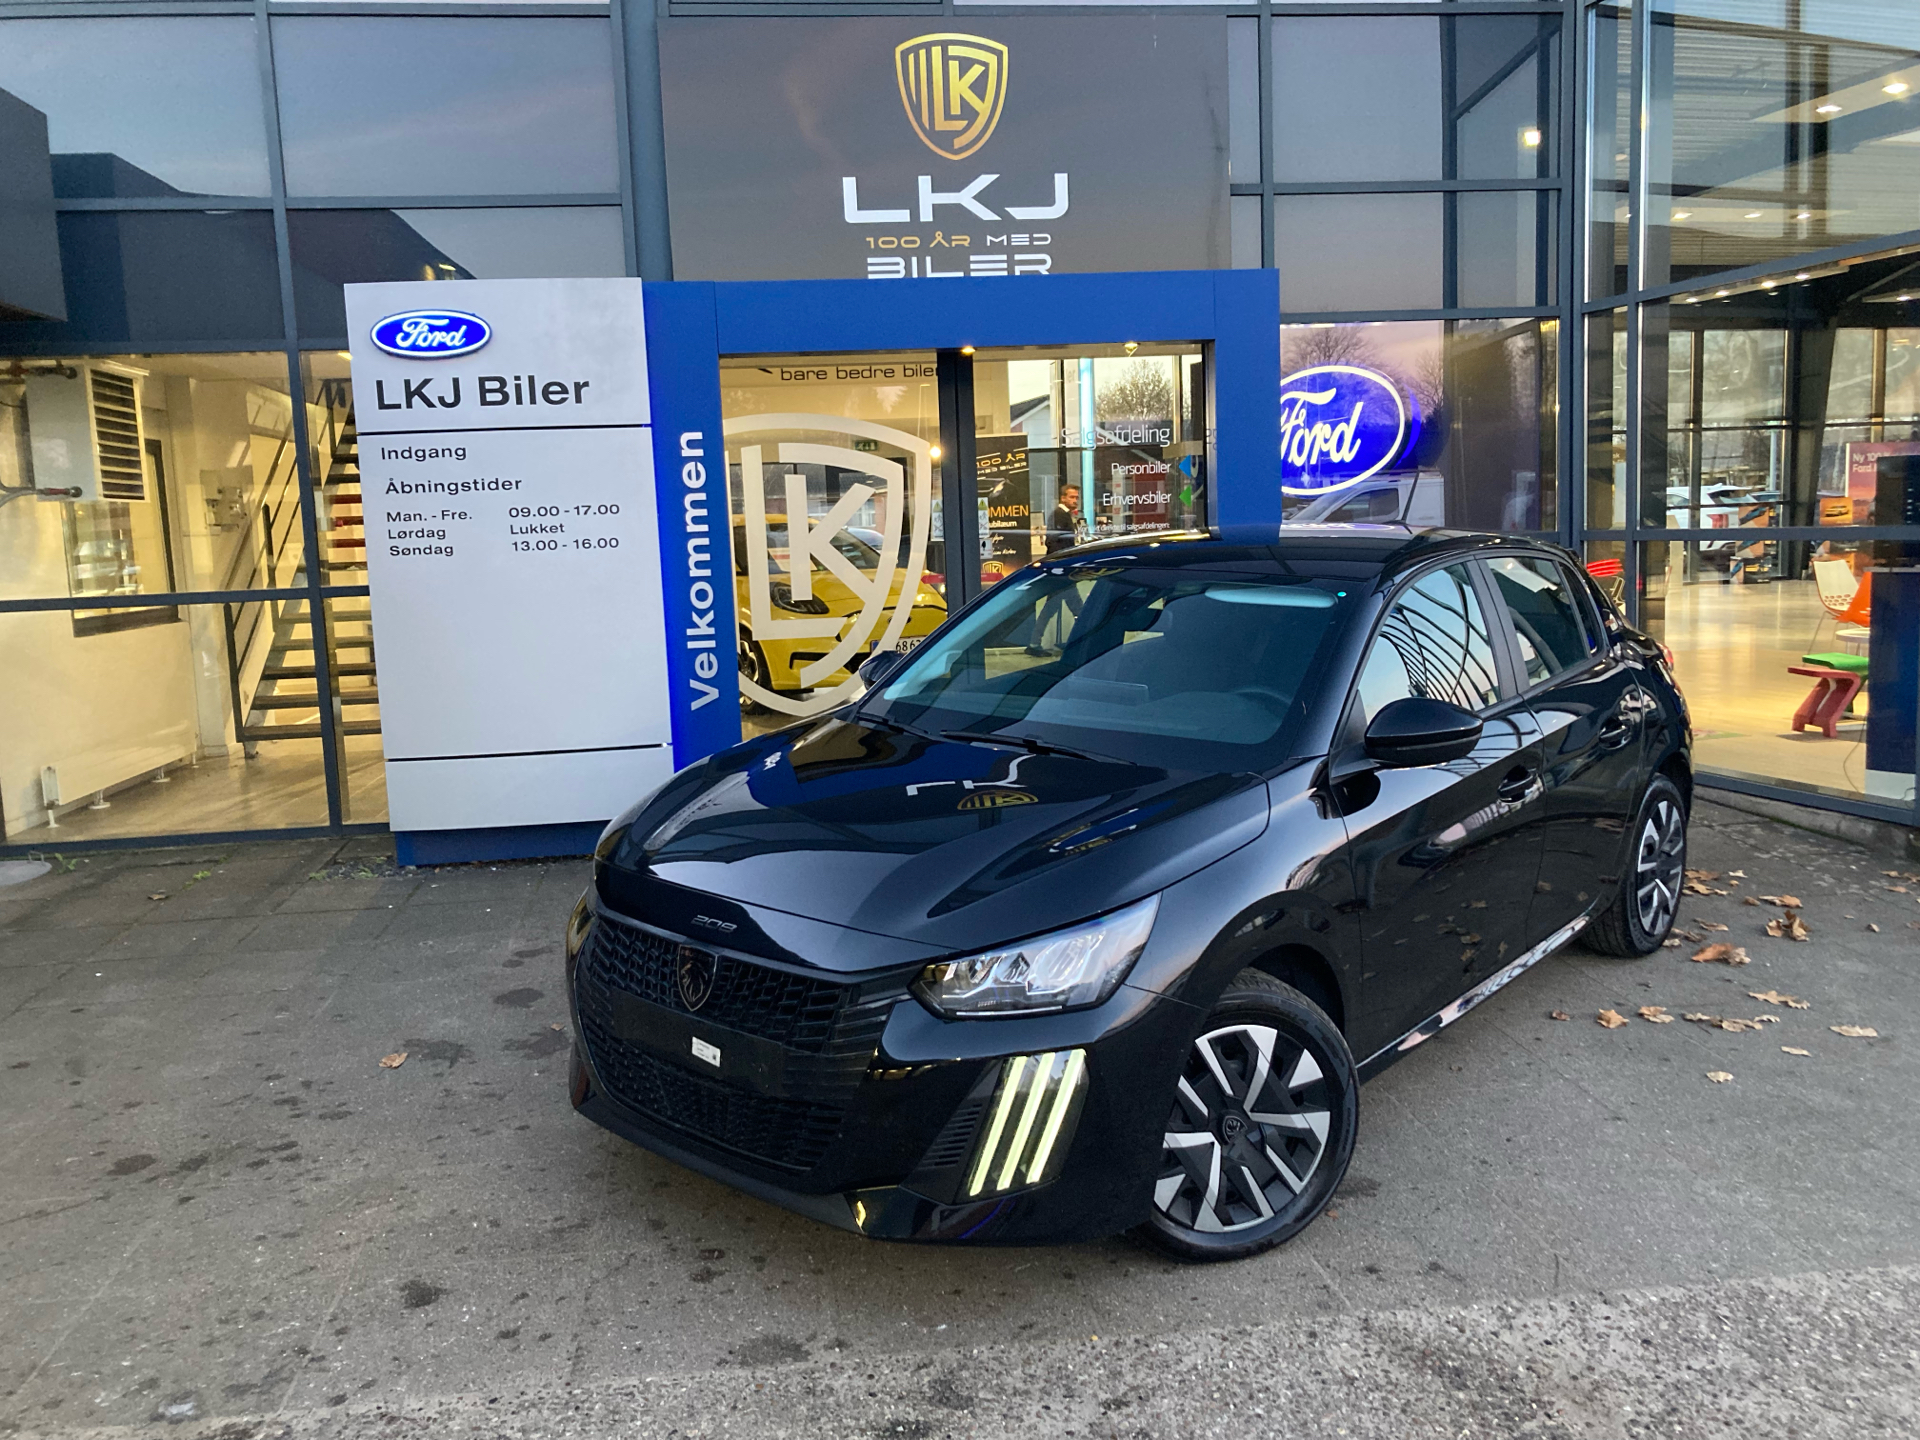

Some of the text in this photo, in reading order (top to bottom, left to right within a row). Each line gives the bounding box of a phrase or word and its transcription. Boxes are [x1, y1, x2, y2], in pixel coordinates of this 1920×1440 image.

[842, 172, 1069, 223] LKJ
[866, 231, 1051, 249] 100 ÅR MED
[867, 253, 1052, 279] BILER
[395, 317, 466, 347] Ford
[781, 368, 828, 381] bare
[836, 365, 895, 380] bedre
[374, 374, 590, 410] LKJ Biler
[1061, 424, 1171, 450] Salgsafdeling
[381, 446, 468, 462] Indgang
[976, 457, 1001, 468] 100
[1111, 460, 1172, 475] Personbiler
[385, 477, 522, 496] Åbningstider
[1102, 490, 1172, 506] Erhvervsbiler
[386, 510, 428, 523] Man.
[441, 509, 473, 521] Fre.
[508, 505, 560, 518] 09.00
[573, 504, 620, 516] 17.00
[987, 504, 1029, 518] MMEN
[388, 528, 446, 540] Lørdag
[510, 523, 565, 535] Lukket
[389, 544, 454, 556] Søndag
[512, 540, 558, 552] 13.00
[573, 537, 620, 550] 16.00
[680, 431, 720, 711] Velkommen
[691, 914, 738, 933] 208
